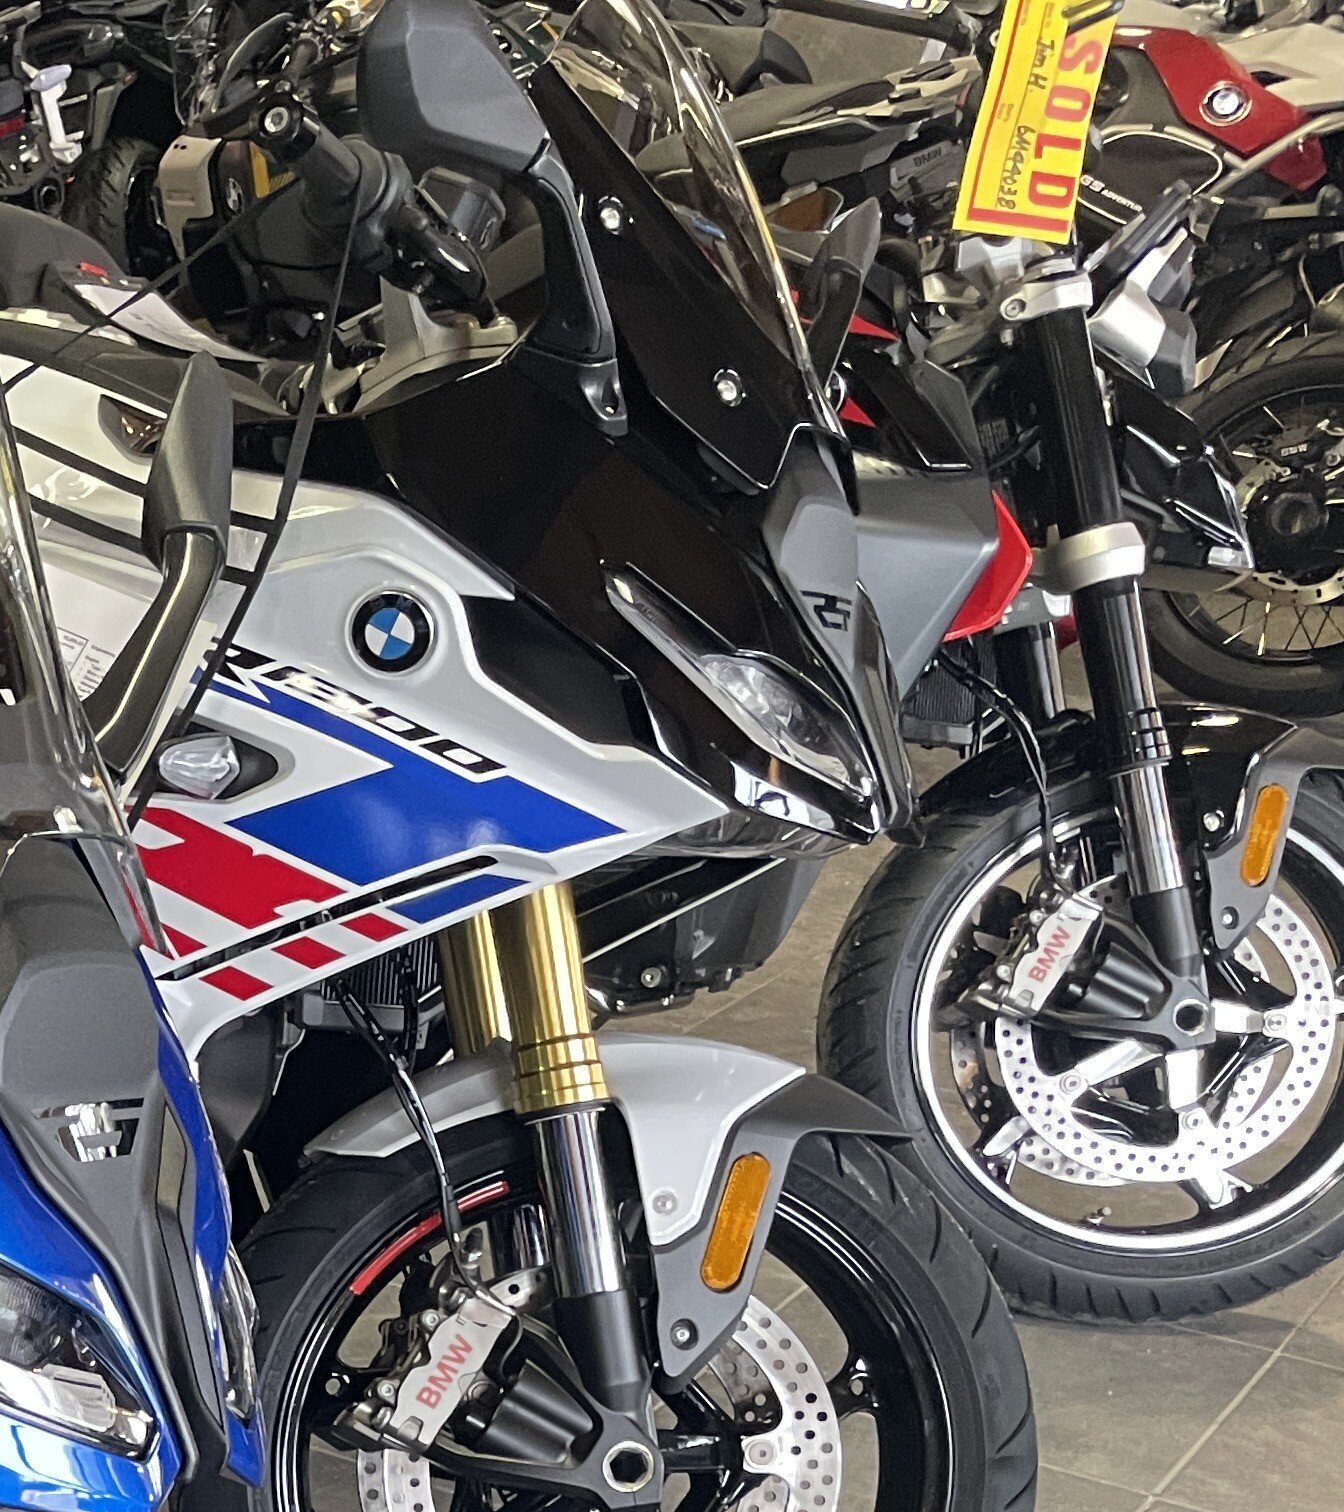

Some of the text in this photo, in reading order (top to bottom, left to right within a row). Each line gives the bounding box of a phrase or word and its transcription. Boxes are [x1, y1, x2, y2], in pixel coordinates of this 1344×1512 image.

[1028, 35, 1103, 209] SOLD
[1027, 924, 1071, 983] BMW
[415, 1333, 474, 1410] BMW
